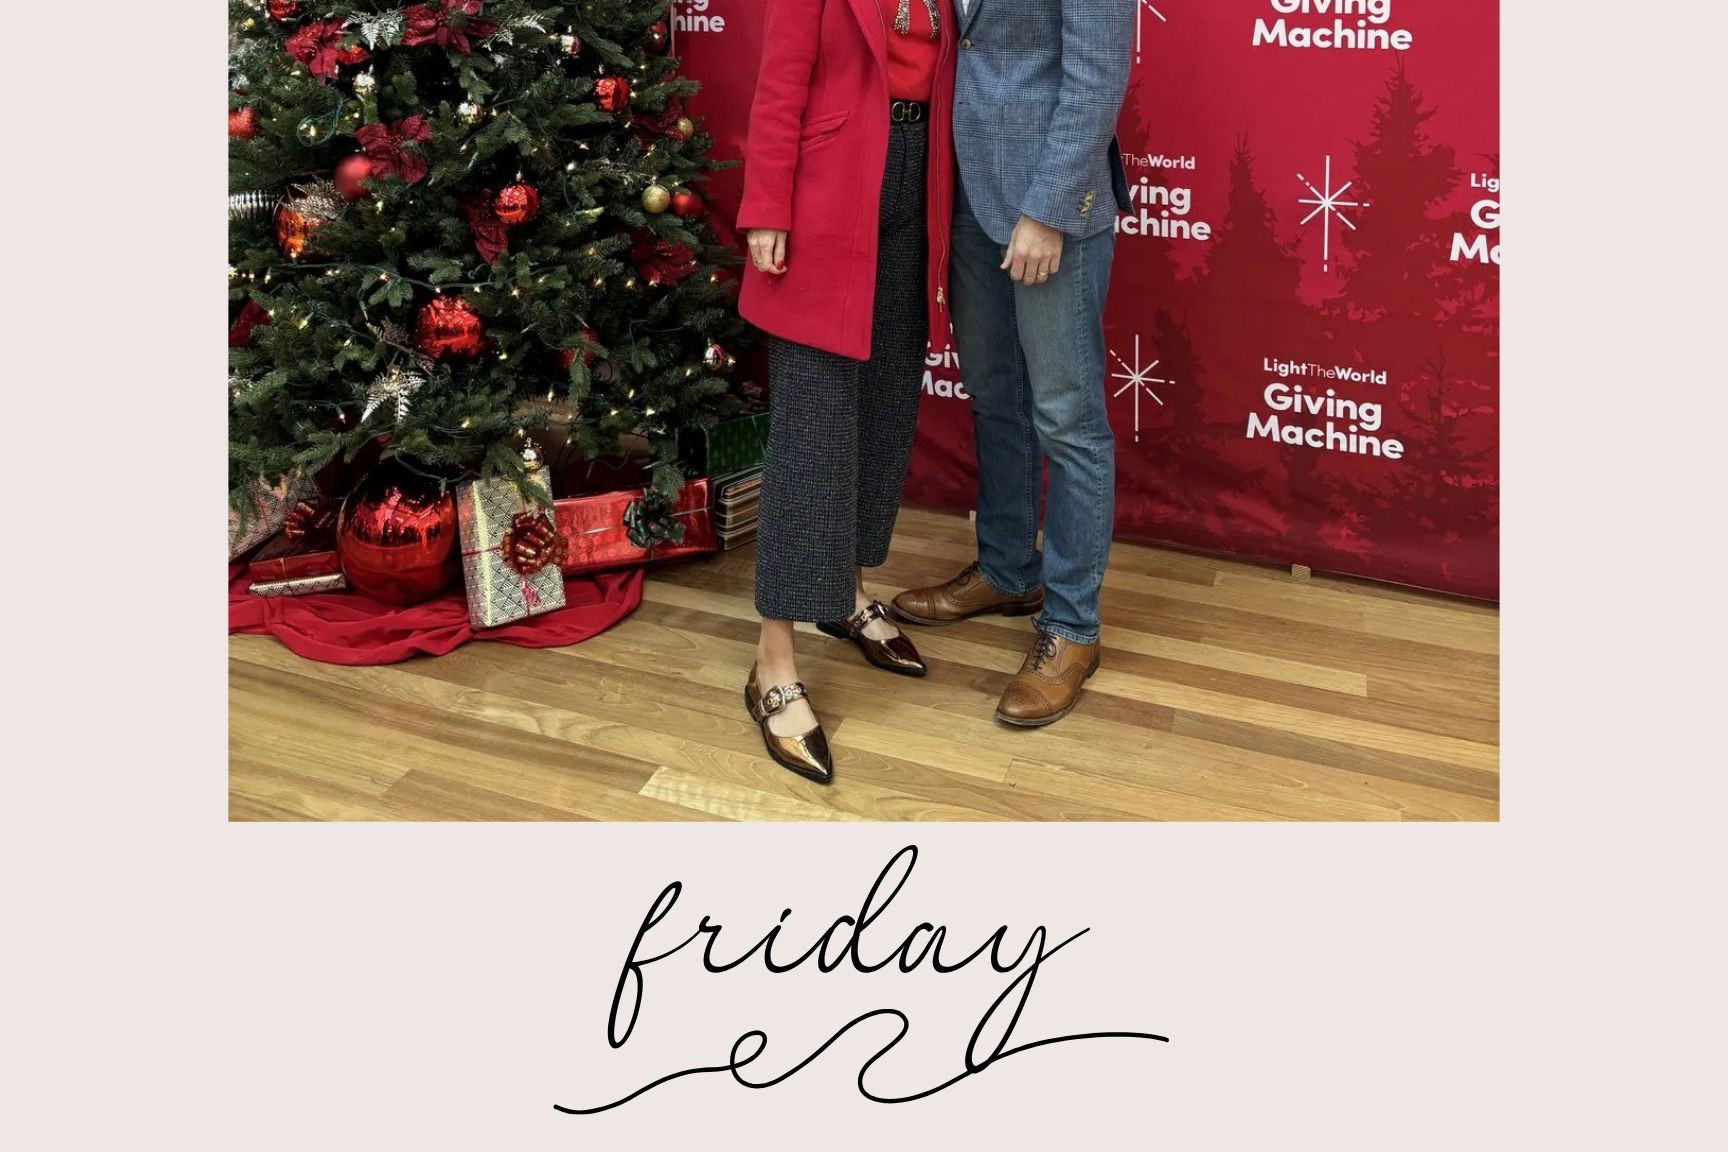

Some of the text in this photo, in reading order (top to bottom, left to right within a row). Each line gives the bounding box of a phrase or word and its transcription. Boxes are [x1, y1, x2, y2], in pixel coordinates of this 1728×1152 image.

[1252, 18, 1413, 50] Machine
[1263, 357, 1387, 385] LightTheWorld
[1262, 382, 1383, 431] Giving
[1246, 412, 1405, 460] Machine
